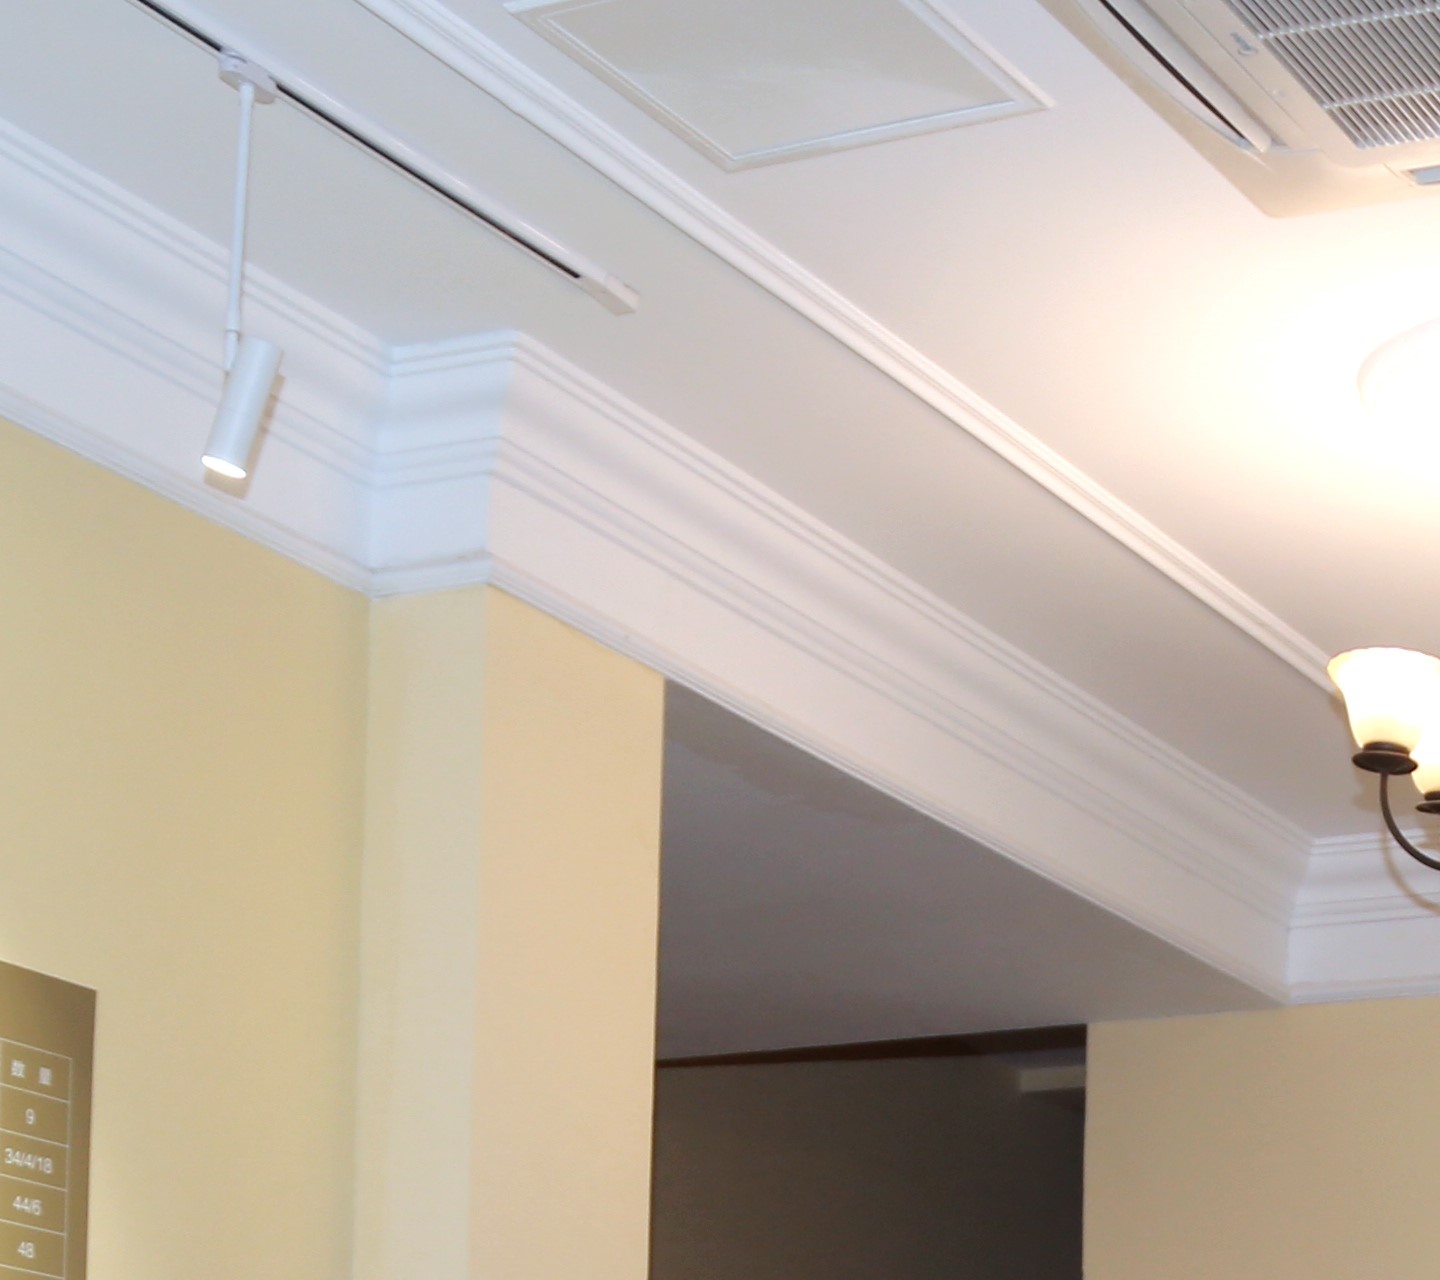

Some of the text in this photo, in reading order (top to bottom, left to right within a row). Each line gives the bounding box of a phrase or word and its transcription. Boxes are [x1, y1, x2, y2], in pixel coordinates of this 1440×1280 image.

[10, 1058, 52, 1088] 数量
[25, 1108, 36, 1125] 9
[4, 1147, 53, 1174] 34/4/18
[12, 1196, 43, 1216] 44/6
[17, 1241, 36, 1260] 48
